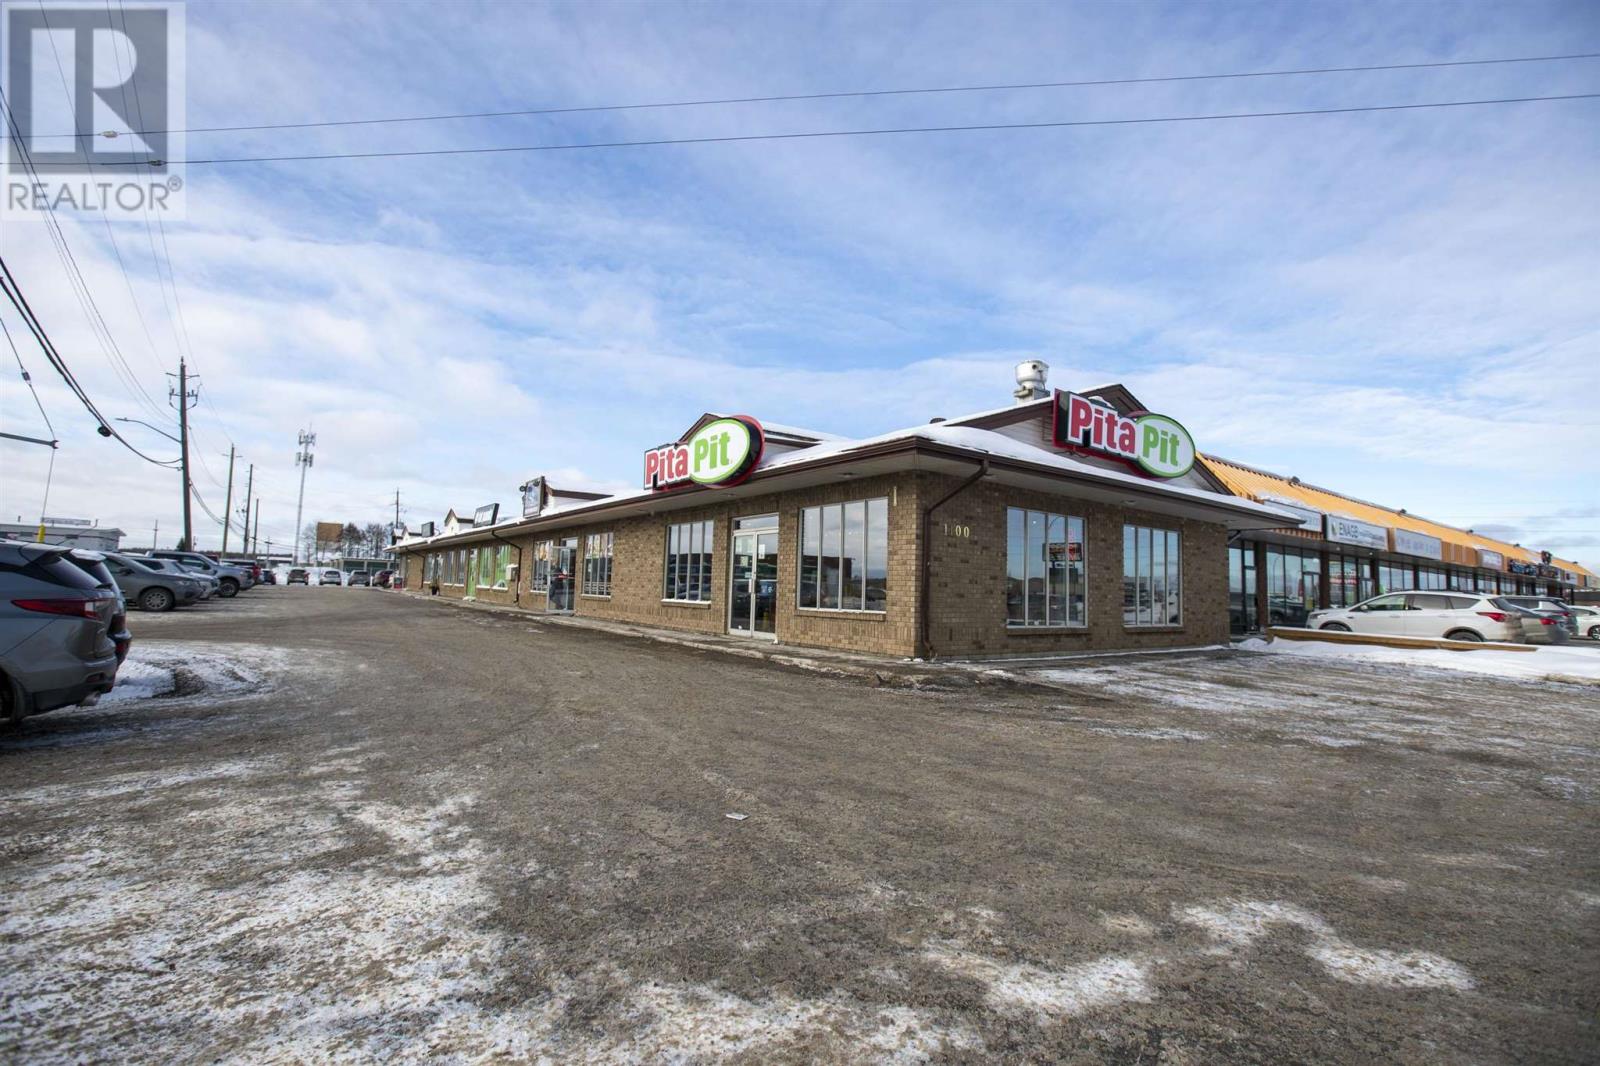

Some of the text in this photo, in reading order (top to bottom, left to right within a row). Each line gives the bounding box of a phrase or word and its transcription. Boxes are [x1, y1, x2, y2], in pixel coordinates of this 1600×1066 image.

[645, 431, 731, 485] Pita Pit
[1070, 397, 1180, 467] Pita Pit
